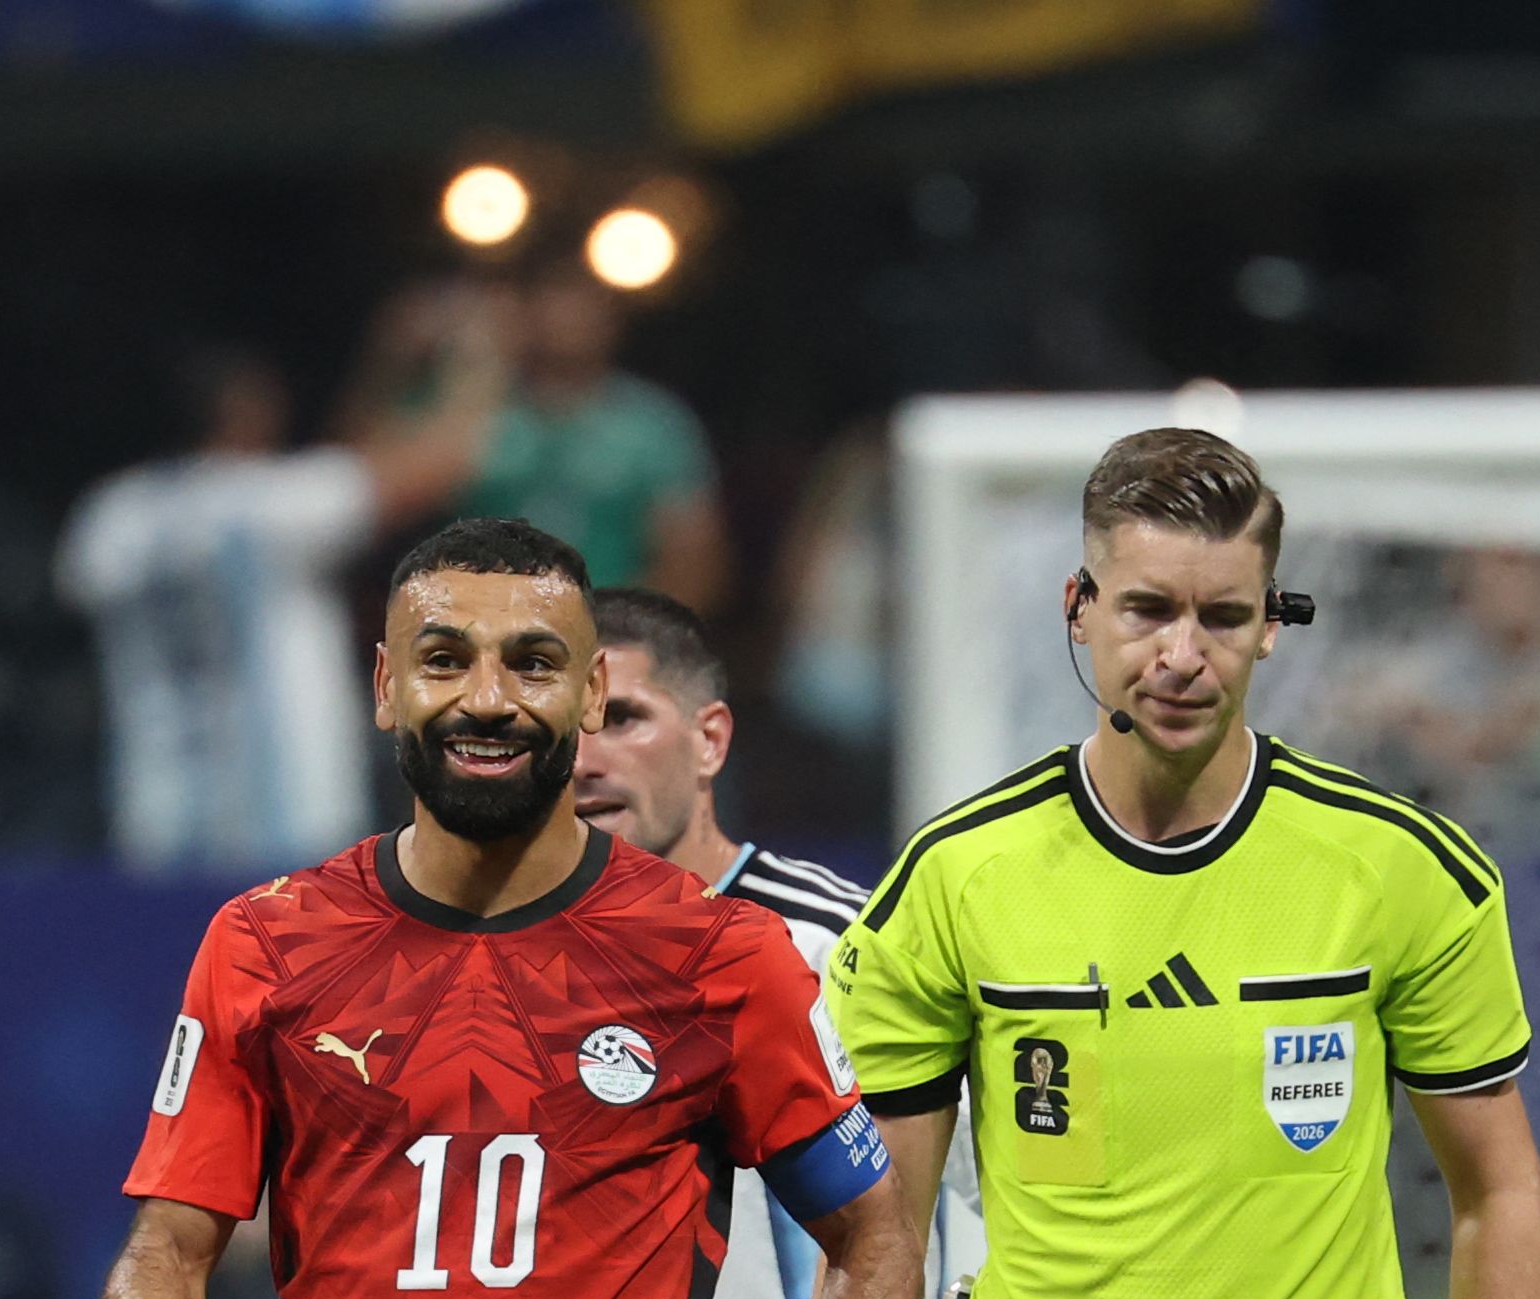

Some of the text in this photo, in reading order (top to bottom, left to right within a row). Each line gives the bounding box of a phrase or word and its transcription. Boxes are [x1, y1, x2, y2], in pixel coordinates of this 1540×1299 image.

[1274, 1032, 1345, 1065] FIFA
[1271, 1082, 1344, 1101] REFEREE
[1029, 1113, 1056, 1128] FIFA
[1292, 1125, 1325, 1141] 2026
[396, 1133, 544, 1290] 10
